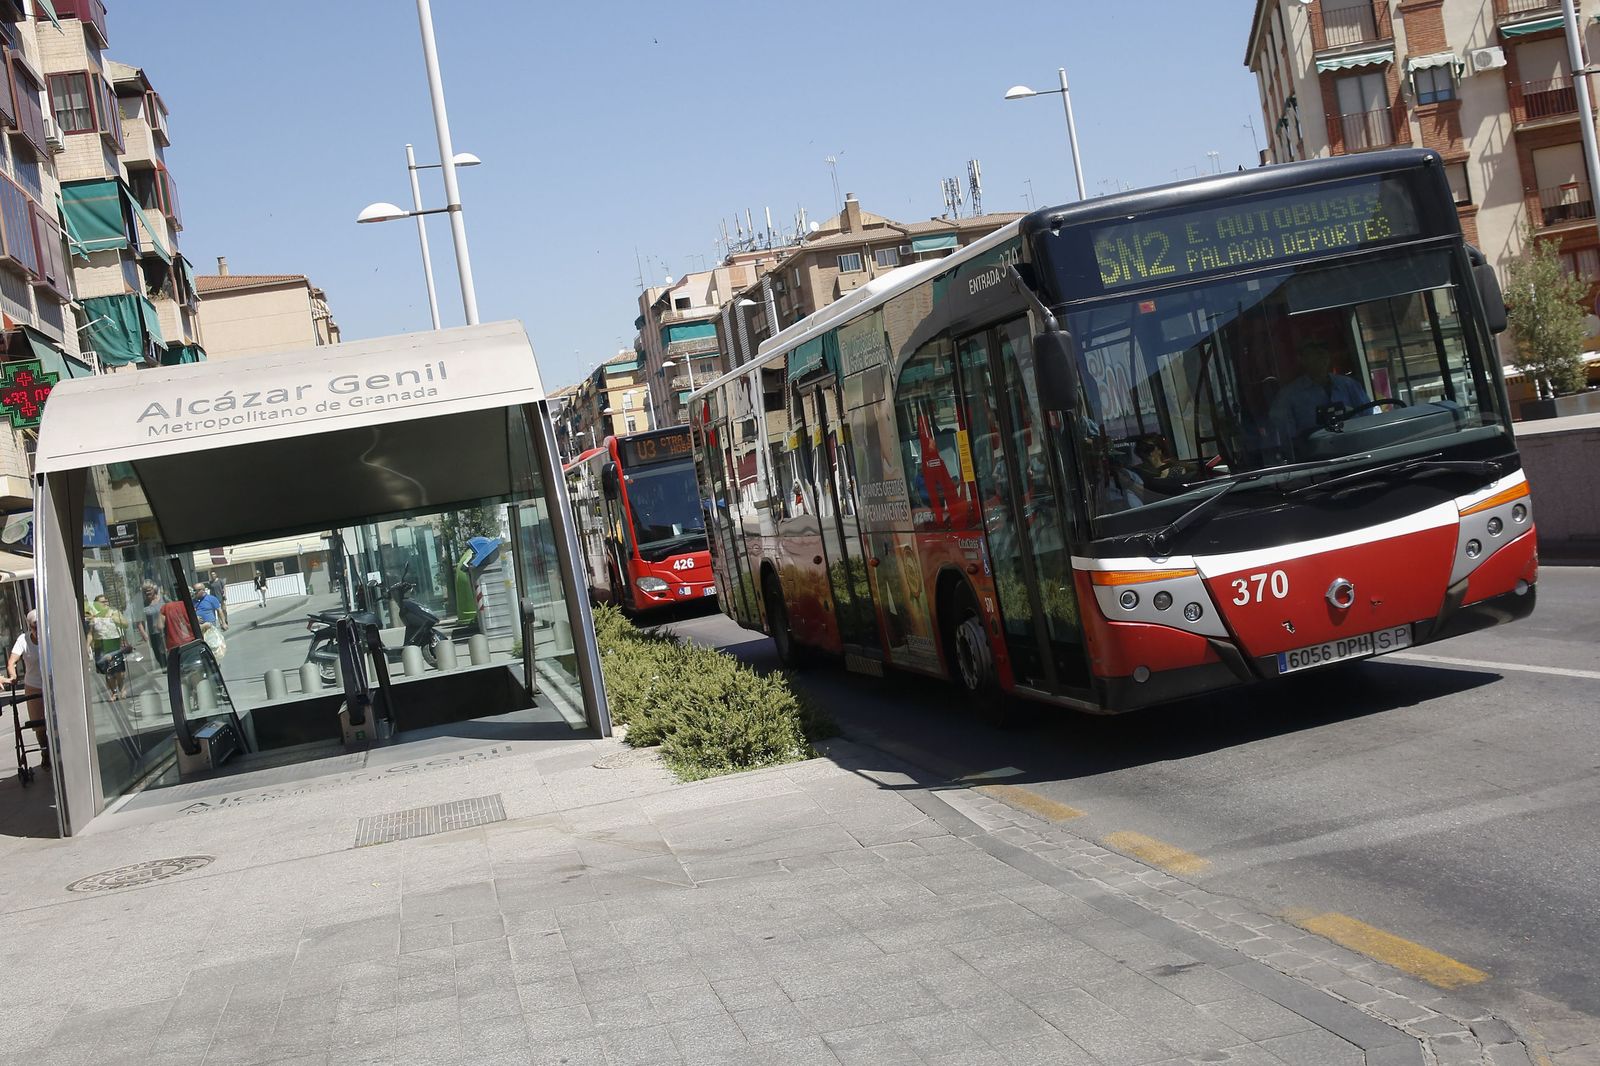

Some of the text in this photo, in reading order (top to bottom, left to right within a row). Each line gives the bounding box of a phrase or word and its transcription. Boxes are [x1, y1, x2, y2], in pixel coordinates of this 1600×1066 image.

[1185, 195, 1383, 245] E. AUTOBUSES
[1094, 231, 1176, 284] SN2
[1186, 216, 1391, 272] PALACIO DEPORTES
[968, 268, 1001, 295] ENTRADA
[136, 360, 448, 423] Alcázar Genil
[148, 386, 438, 437] Metropolitano de Granada
[637, 438, 657, 460] U3
[865, 500, 909, 522] PERMANENTES
[673, 557, 695, 571] 426
[1231, 569, 1289, 606] 370
[1288, 645, 1331, 668] 6056
[1336, 635, 1369, 657] DPH
